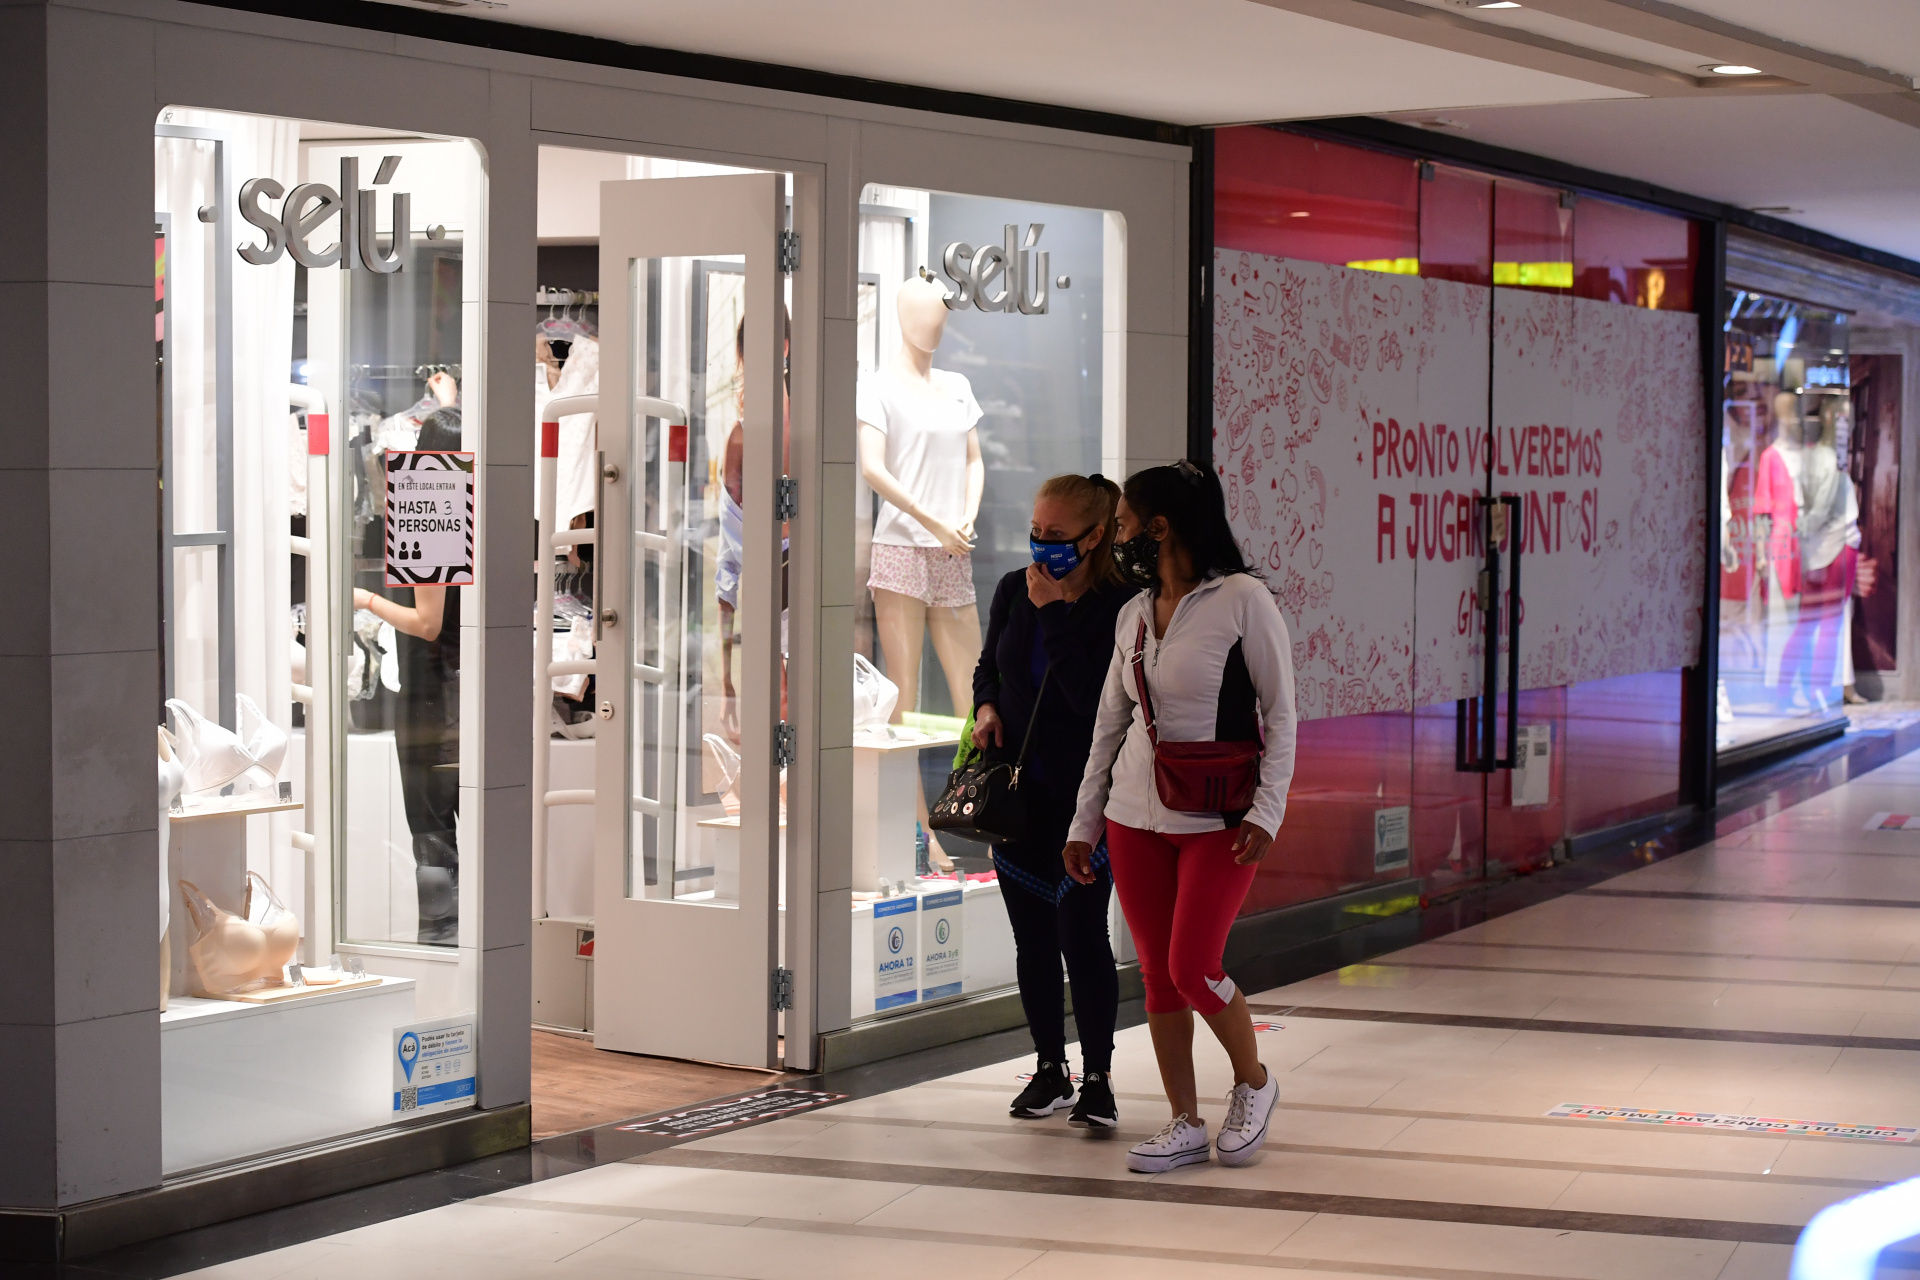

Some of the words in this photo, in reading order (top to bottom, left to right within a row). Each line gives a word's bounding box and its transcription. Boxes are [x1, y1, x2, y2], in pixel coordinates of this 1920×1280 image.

[237, 156, 411, 273] selú
[942, 223, 1050, 315] selú
[1373, 417, 1459, 479] PRONTO
[1466, 423, 1603, 478] VOLVEREMOS
[398, 482, 405, 490] EN
[406, 482, 418, 490] ESTE
[419, 482, 435, 490] LOCAL
[436, 482, 456, 490] ENTRAN
[398, 501, 437, 514] HASTA
[444, 500, 452, 515] 3
[398, 519, 461, 532] PERSONAS
[1378, 493, 1396, 563] A
[1406, 488, 1485, 562] JUGAR
[926, 952, 946, 962] AHORA
[879, 958, 904, 973] AHORA
[906, 957, 914, 967] 12
[403, 1042, 416, 1053] Acá
[1569, 1107, 1790, 1129] CONSTANTEMENTE
[1795, 1124, 1898, 1137] CIRCULE
